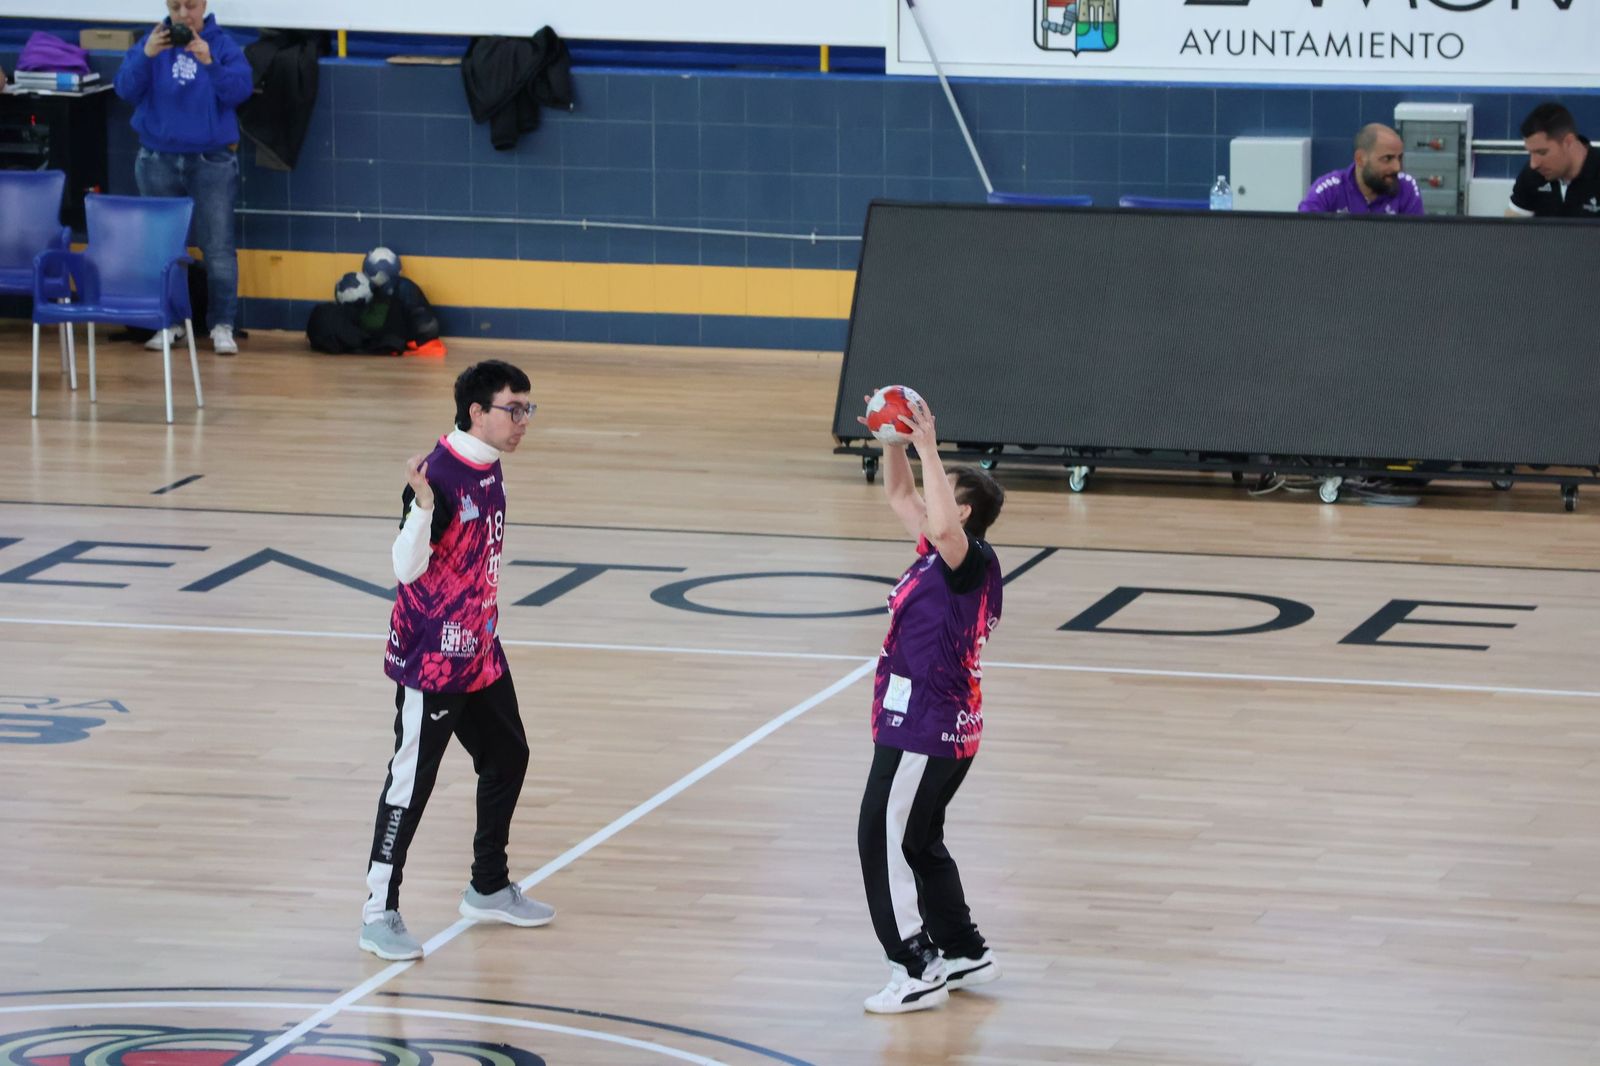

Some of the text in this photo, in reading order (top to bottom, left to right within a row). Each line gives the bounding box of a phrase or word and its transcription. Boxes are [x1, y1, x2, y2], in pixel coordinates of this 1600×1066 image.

[1180, 29, 1465, 60] AYUNTAMIENTO
[486, 510, 503, 546] 18
[1056, 586, 1538, 651] DE
